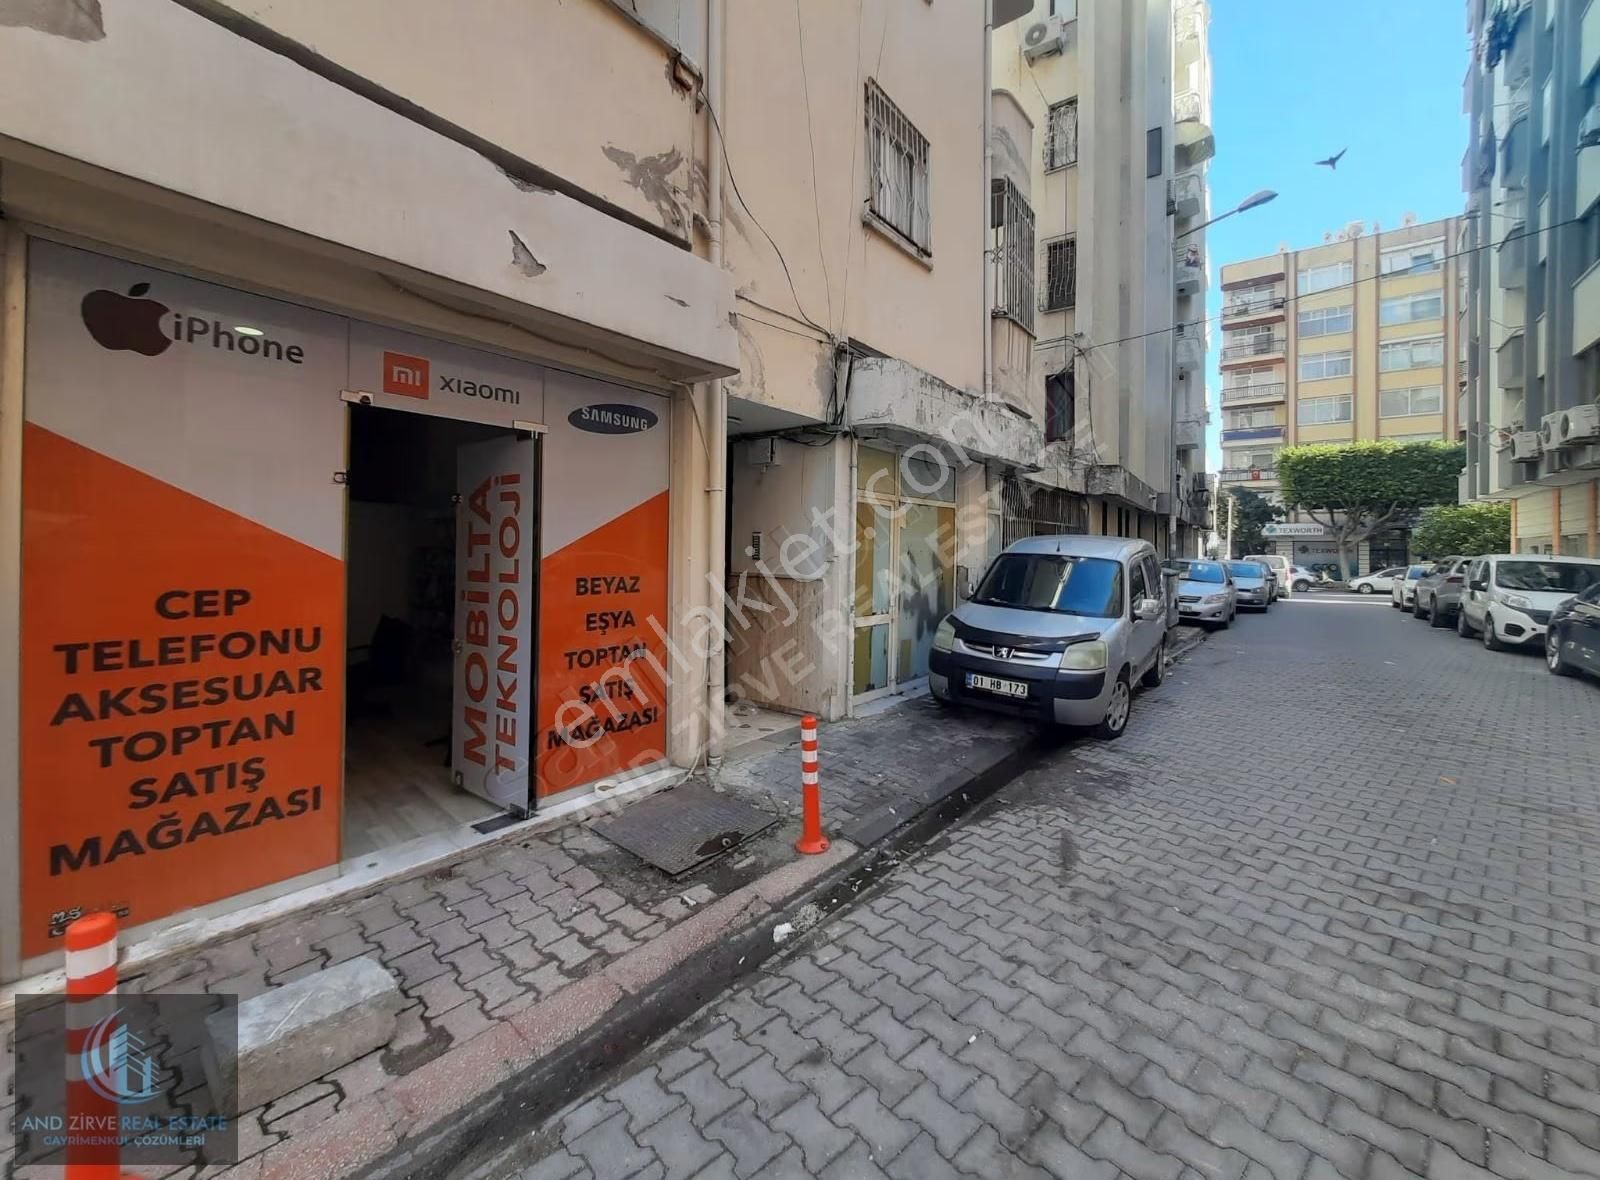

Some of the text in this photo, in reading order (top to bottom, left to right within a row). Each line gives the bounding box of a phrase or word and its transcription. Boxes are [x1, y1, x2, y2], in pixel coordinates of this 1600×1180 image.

[173, 313, 304, 364] iPhone
[581, 407, 649, 431] SAMSUNG
[155, 588, 251, 620] CEP
[575, 576, 641, 597] BEYAZ
[461, 476, 492, 768] MOBİLTA
[495, 473, 521, 777] TEKNOLOJİ
[585, 610, 637, 635] EŞYA
[54, 626, 322, 674] TELEFONU
[564, 642, 648, 670] TOPTAN
[50, 667, 323, 726] AKSESUAR
[579, 678, 635, 705] SATIŞ
[973, 675, 1026, 695] 01 HB 173
[89, 710, 295, 768] TOPTAN
[546, 706, 658, 750] MAĞAZASI
[129, 756, 266, 810] SATIŞ
[50, 785, 322, 877] MAĞAZASI
